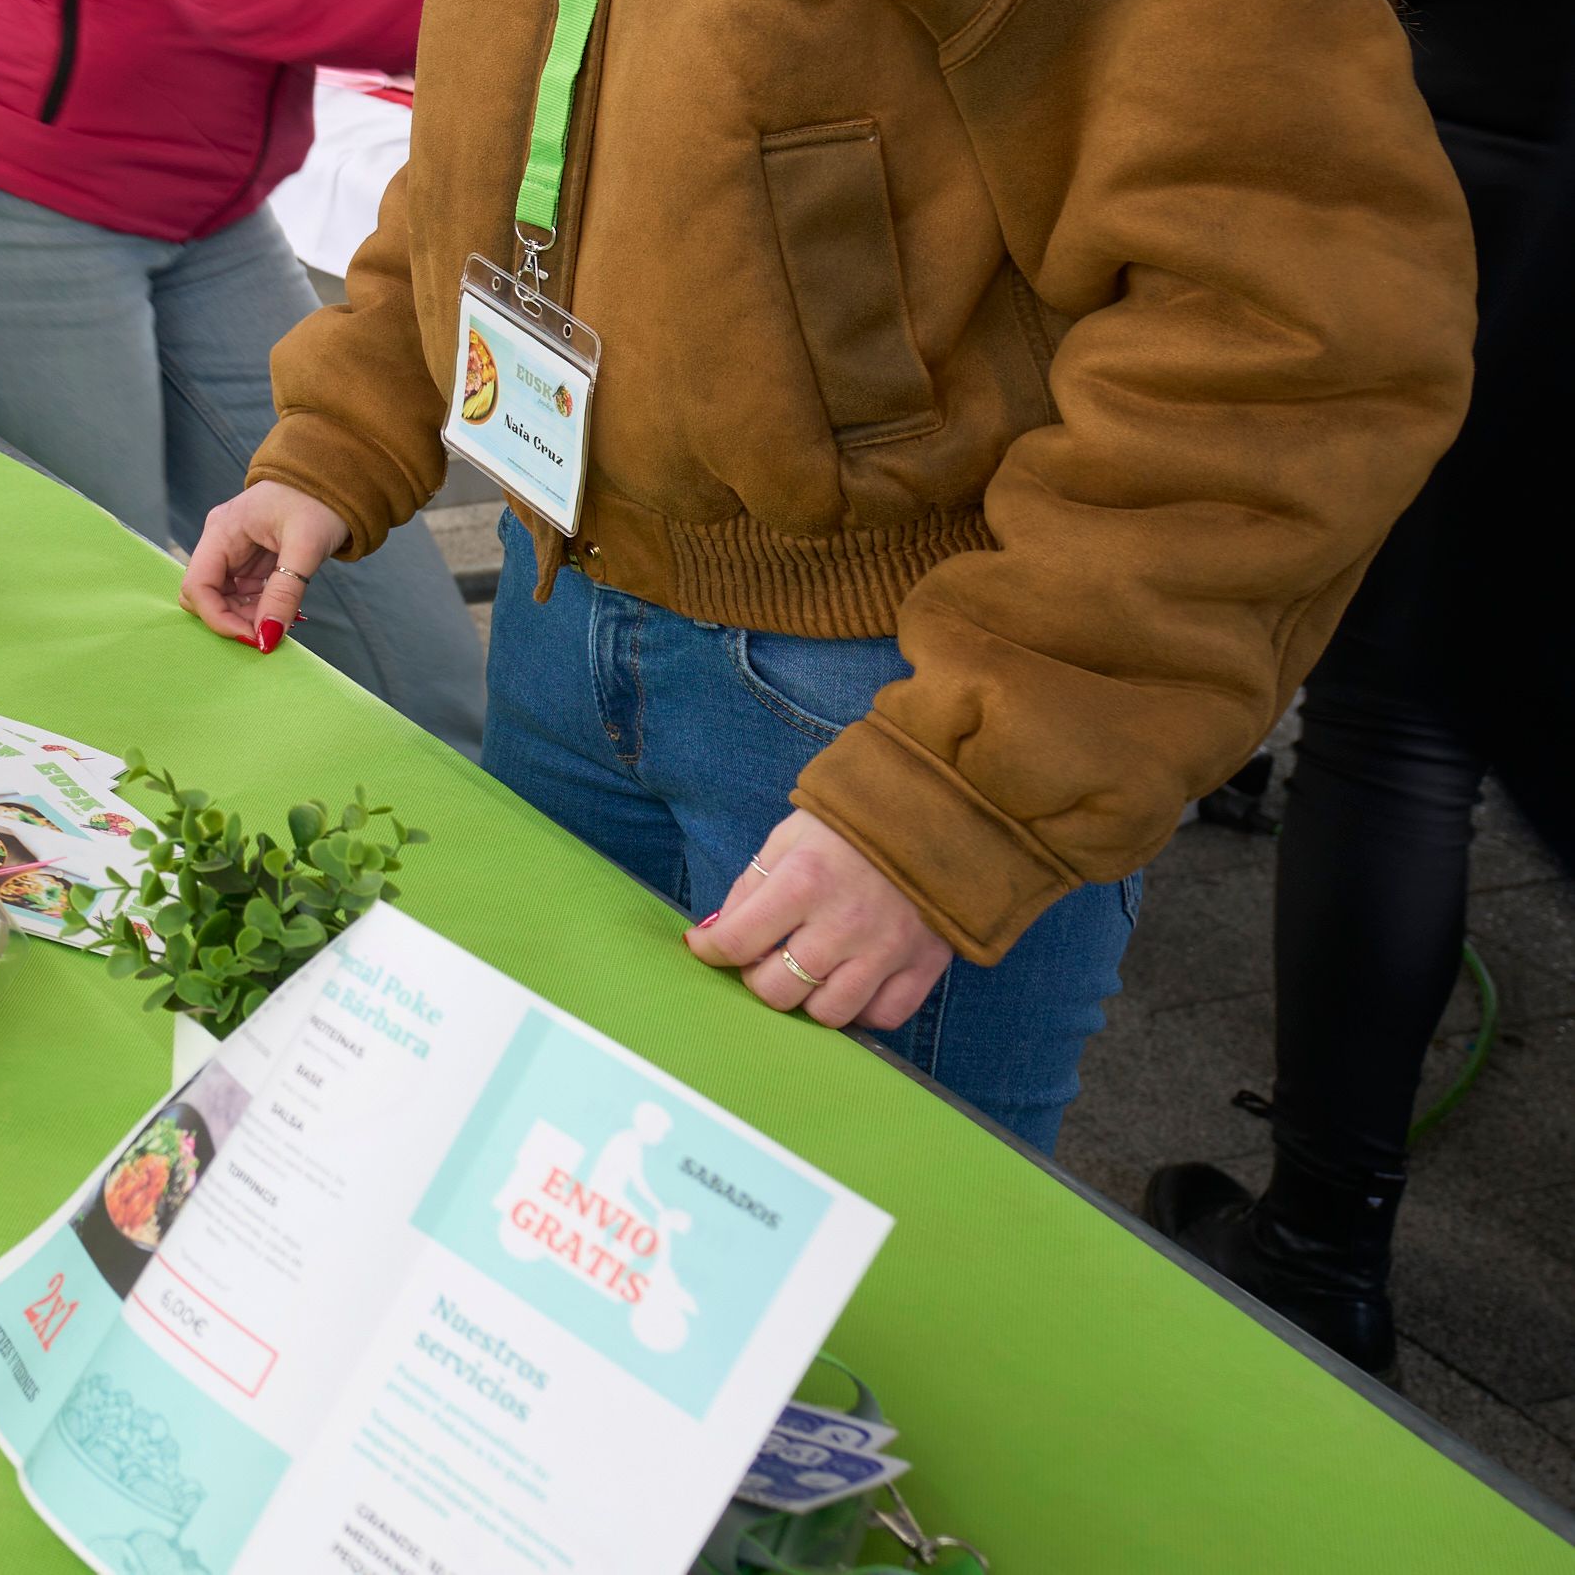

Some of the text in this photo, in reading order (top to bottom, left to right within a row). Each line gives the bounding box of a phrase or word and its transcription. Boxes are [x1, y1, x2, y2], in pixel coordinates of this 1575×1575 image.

[516, 363, 554, 401] EUSK
[503, 412, 564, 467] Naia Cruz
[33, 762, 106, 812] EUSK
[381, 973, 444, 1027] Poke
[510, 1198, 651, 1305] GRATIS
[23, 1272, 80, 1353] 2x1
[160, 1289, 209, 1338] 6,00€
[430, 1294, 550, 1392] Nuestros
[414, 1330, 531, 1422] servicios
